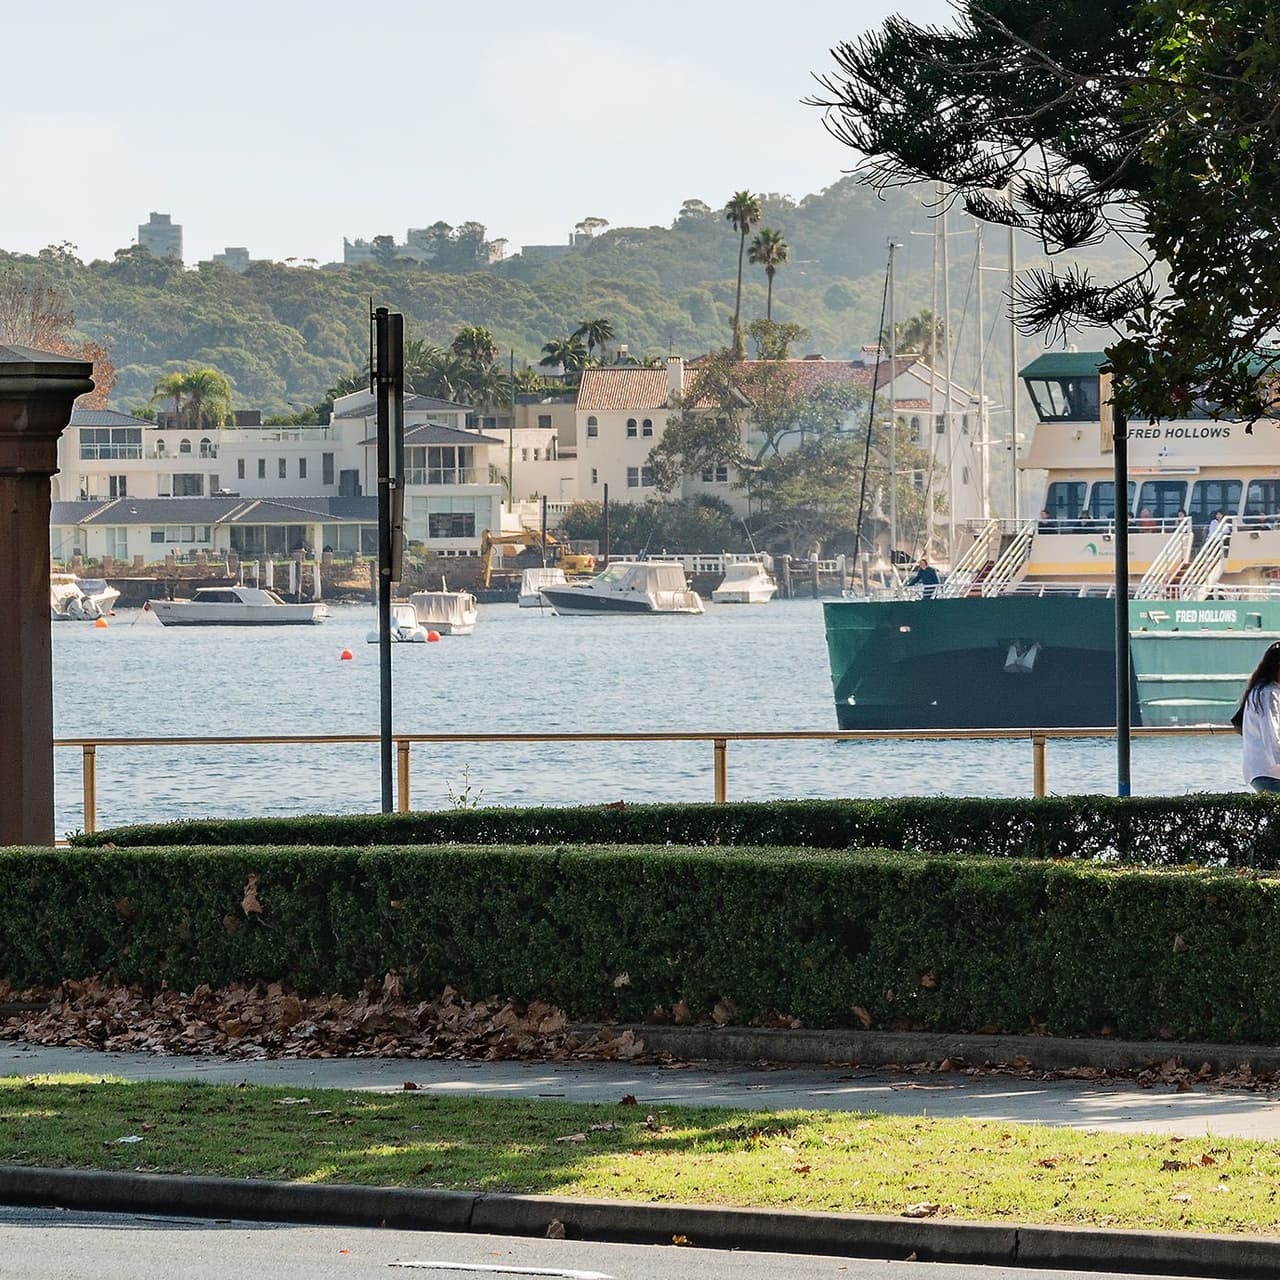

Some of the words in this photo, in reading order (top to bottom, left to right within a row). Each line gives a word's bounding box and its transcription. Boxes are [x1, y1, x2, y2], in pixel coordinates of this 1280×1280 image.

[1128, 427, 1161, 439] FRED
[1165, 427, 1231, 439] HOLLOWS
[1175, 609, 1198, 623] FRED
[1199, 609, 1237, 623] HOLLOWS
